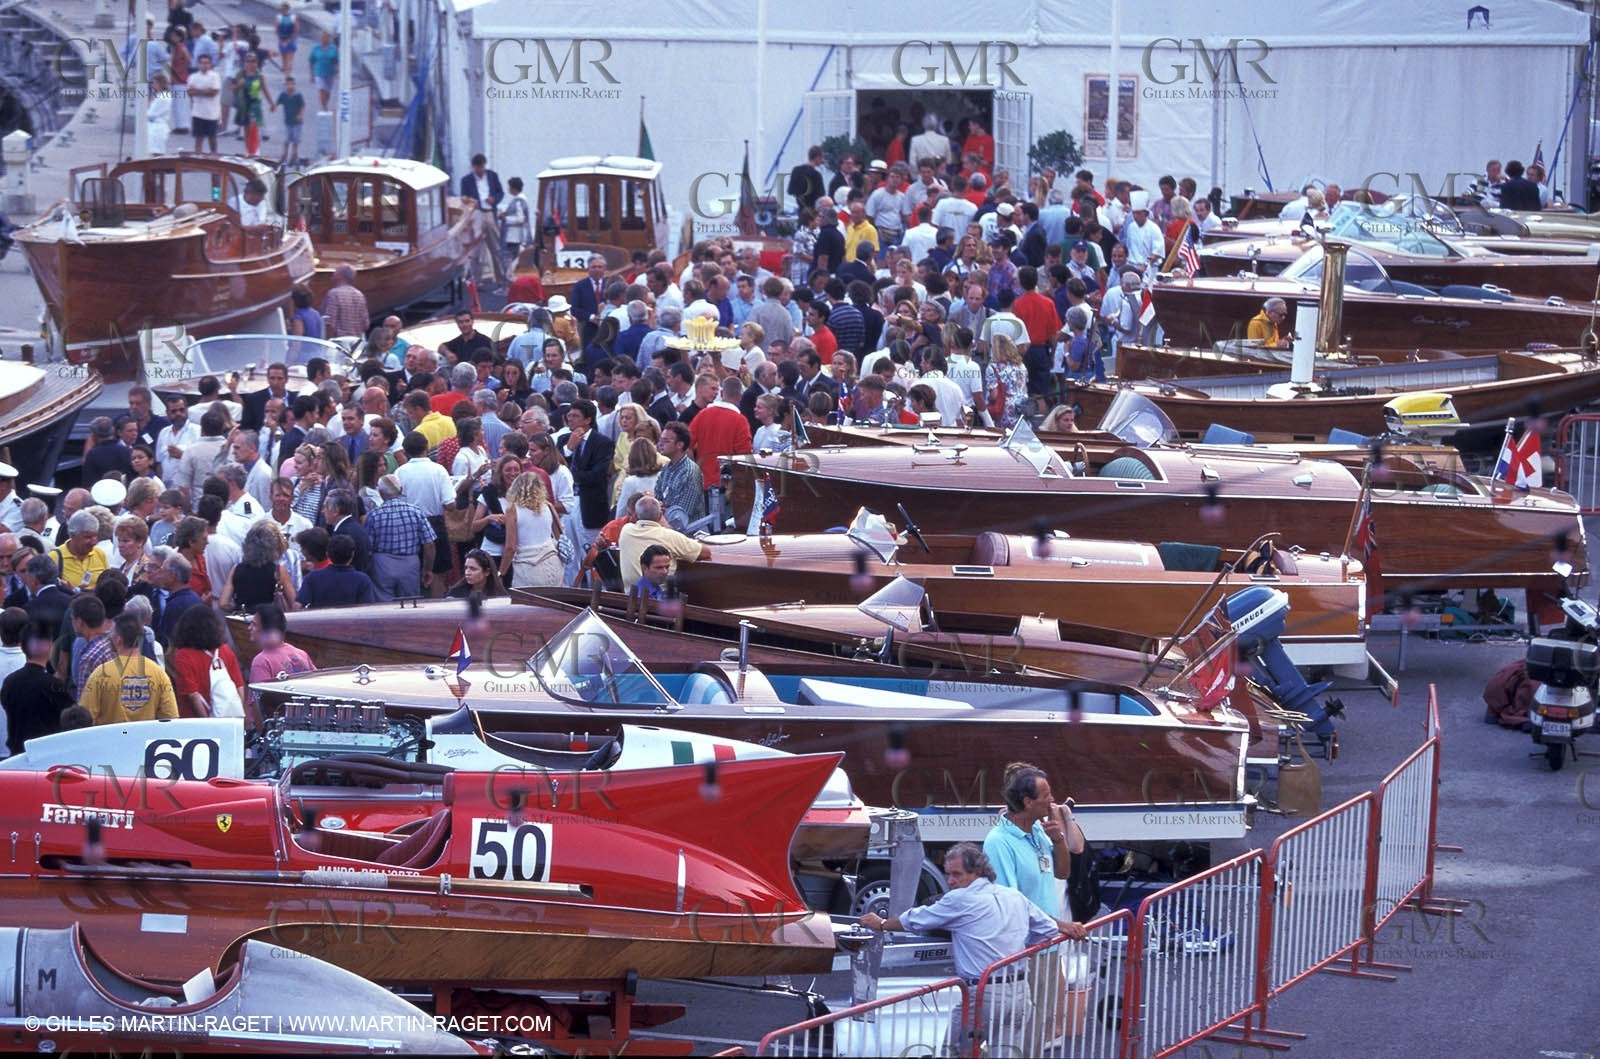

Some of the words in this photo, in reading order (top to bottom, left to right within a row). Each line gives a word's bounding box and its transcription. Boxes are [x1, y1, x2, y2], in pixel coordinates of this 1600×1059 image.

[145, 738, 220, 781] 60
[40, 803, 135, 829] Ferrari
[472, 822, 547, 882] 50
[38, 968, 56, 991] M
